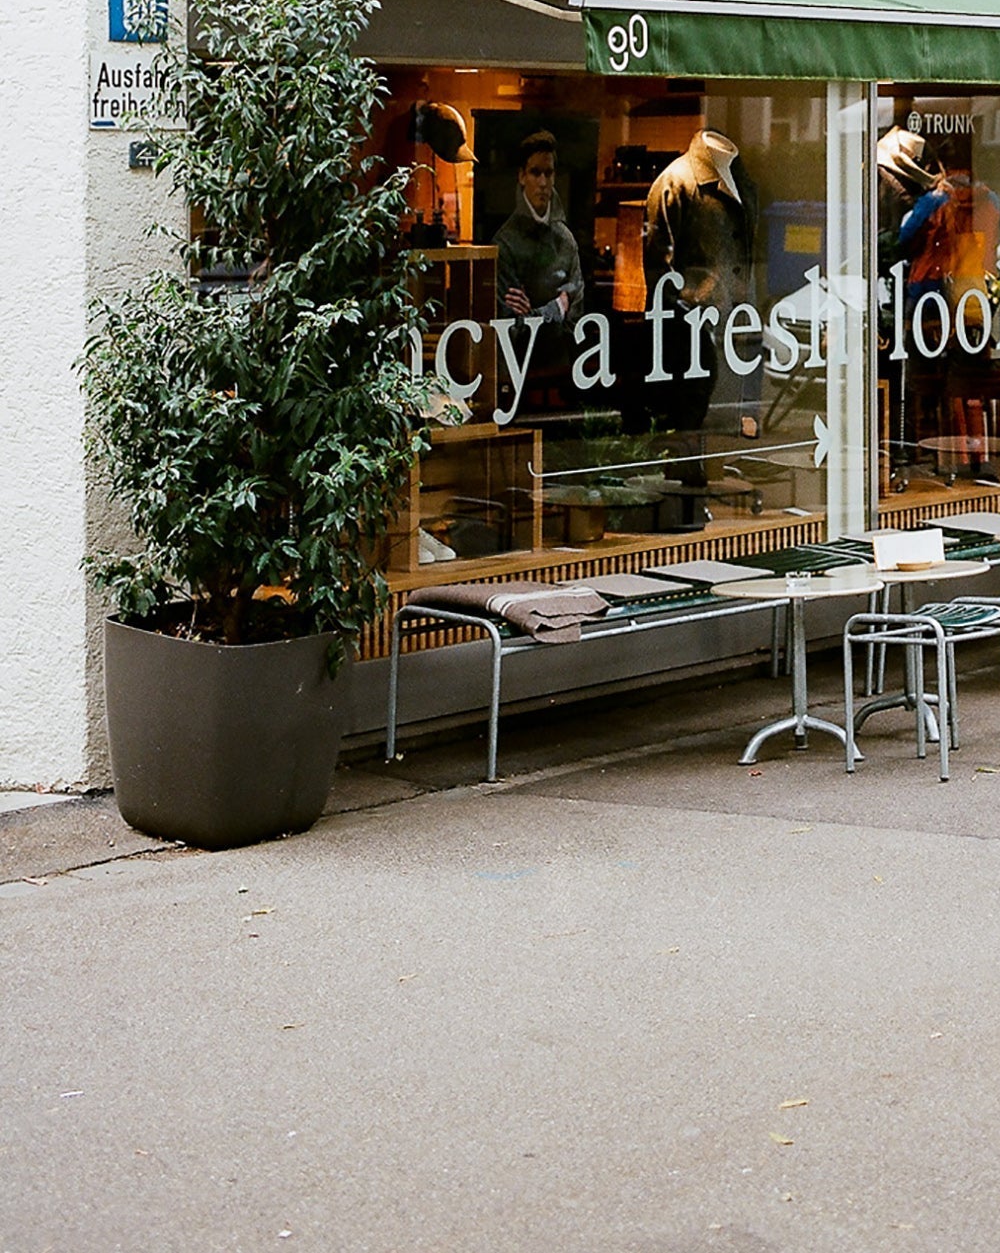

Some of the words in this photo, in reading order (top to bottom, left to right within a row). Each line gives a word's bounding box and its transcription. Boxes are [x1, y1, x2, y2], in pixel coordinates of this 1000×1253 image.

[924, 112, 976, 135] TRUNK
[385, 317, 544, 425] ncy
[572, 313, 616, 390] a
[645, 264, 848, 383] fresh
